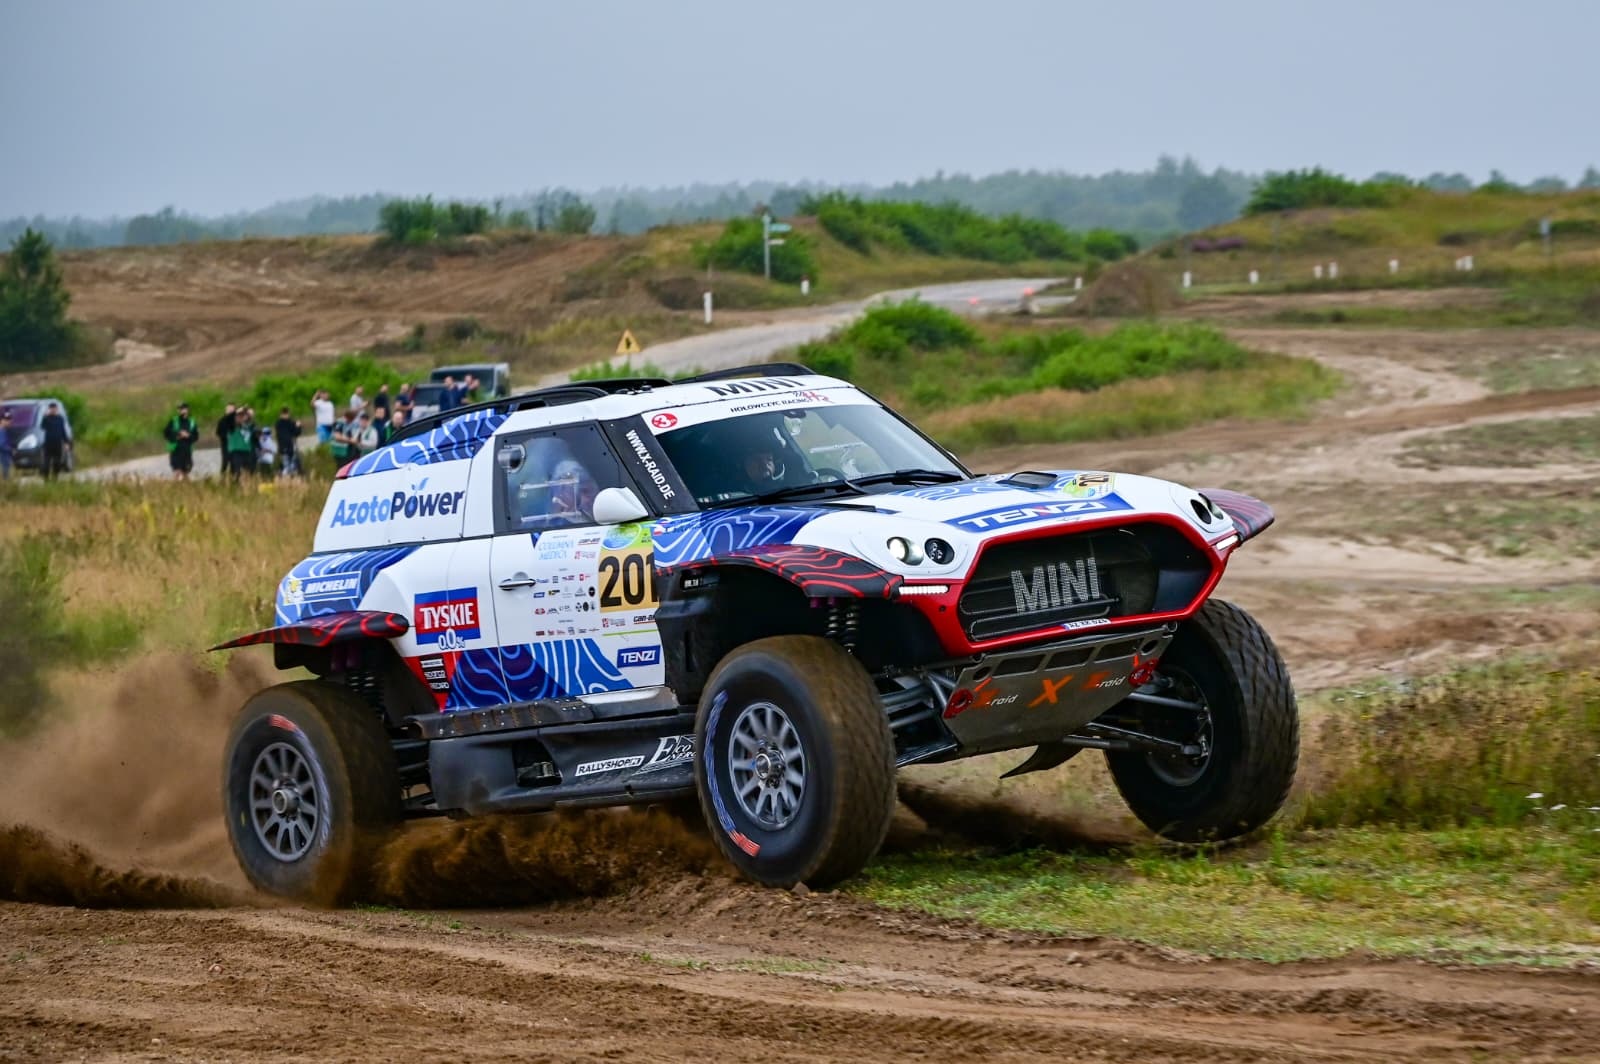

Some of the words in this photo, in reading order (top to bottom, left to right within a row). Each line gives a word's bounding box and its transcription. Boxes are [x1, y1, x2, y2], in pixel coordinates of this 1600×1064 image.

[703, 378, 806, 396] MINI
[625, 429, 676, 500] WWW.X-RAID.DE
[329, 490, 466, 528] AzotoPower
[957, 501, 1108, 528] TENZI
[304, 578, 359, 594] MICHELIN
[598, 552, 659, 609] 201
[1010, 556, 1100, 613] MINI
[419, 602, 476, 630] TYSKIE
[621, 649, 657, 664] TENZI
[1026, 673, 1076, 709] X
